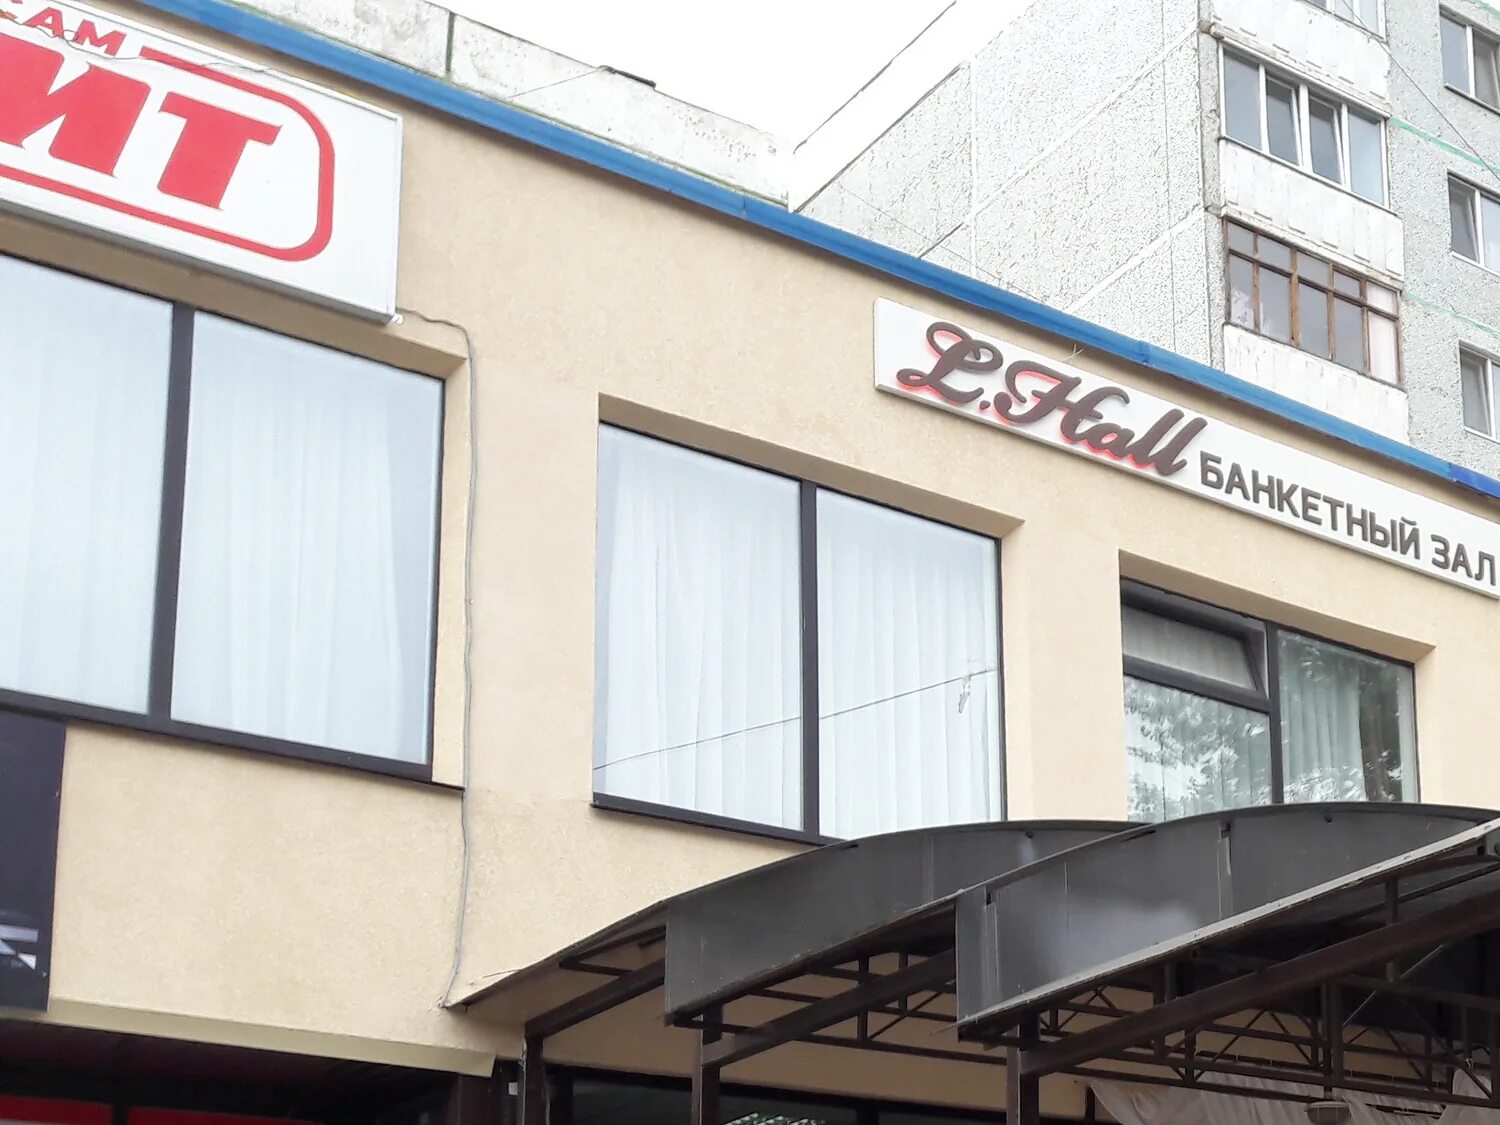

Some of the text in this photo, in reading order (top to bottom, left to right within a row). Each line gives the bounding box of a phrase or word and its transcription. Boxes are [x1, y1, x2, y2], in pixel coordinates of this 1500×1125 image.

[0, 0, 127, 57] АМ
[1200, 450, 1497, 587] БАНКЕТНЫЙ ЗАЛ
